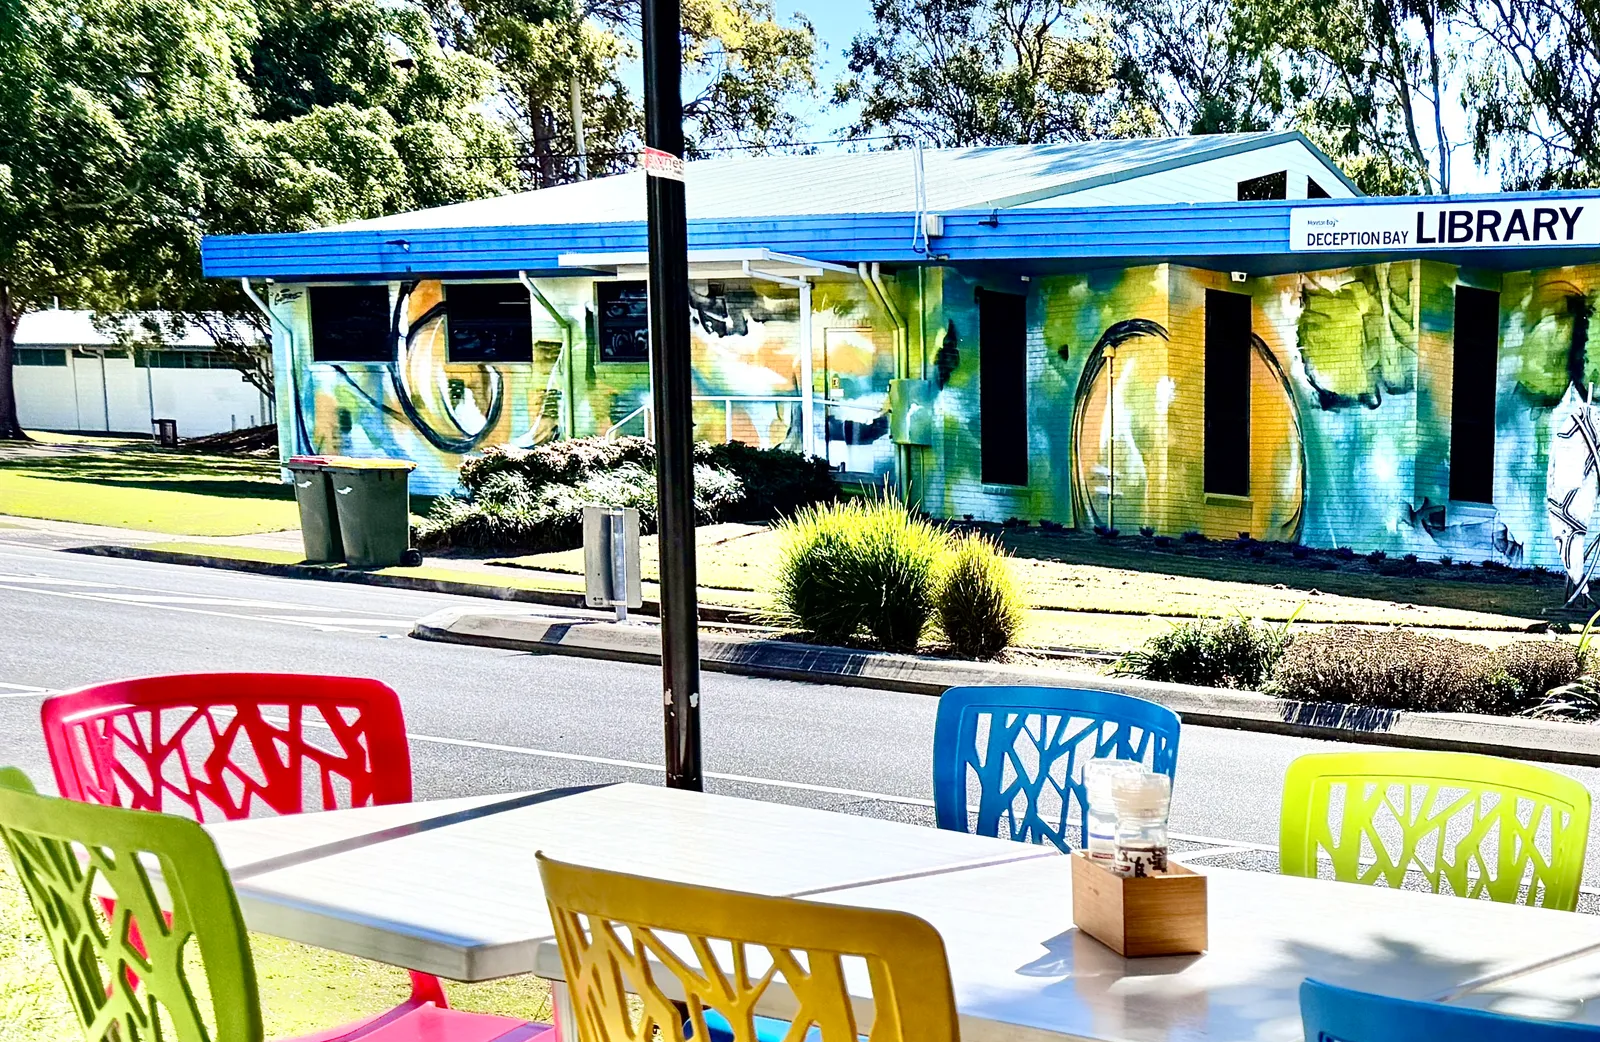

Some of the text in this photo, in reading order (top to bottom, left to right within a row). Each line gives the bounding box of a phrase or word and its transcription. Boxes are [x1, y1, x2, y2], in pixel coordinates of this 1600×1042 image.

[1306, 206, 1585, 247] DECEPTION BAY LIBRARY
